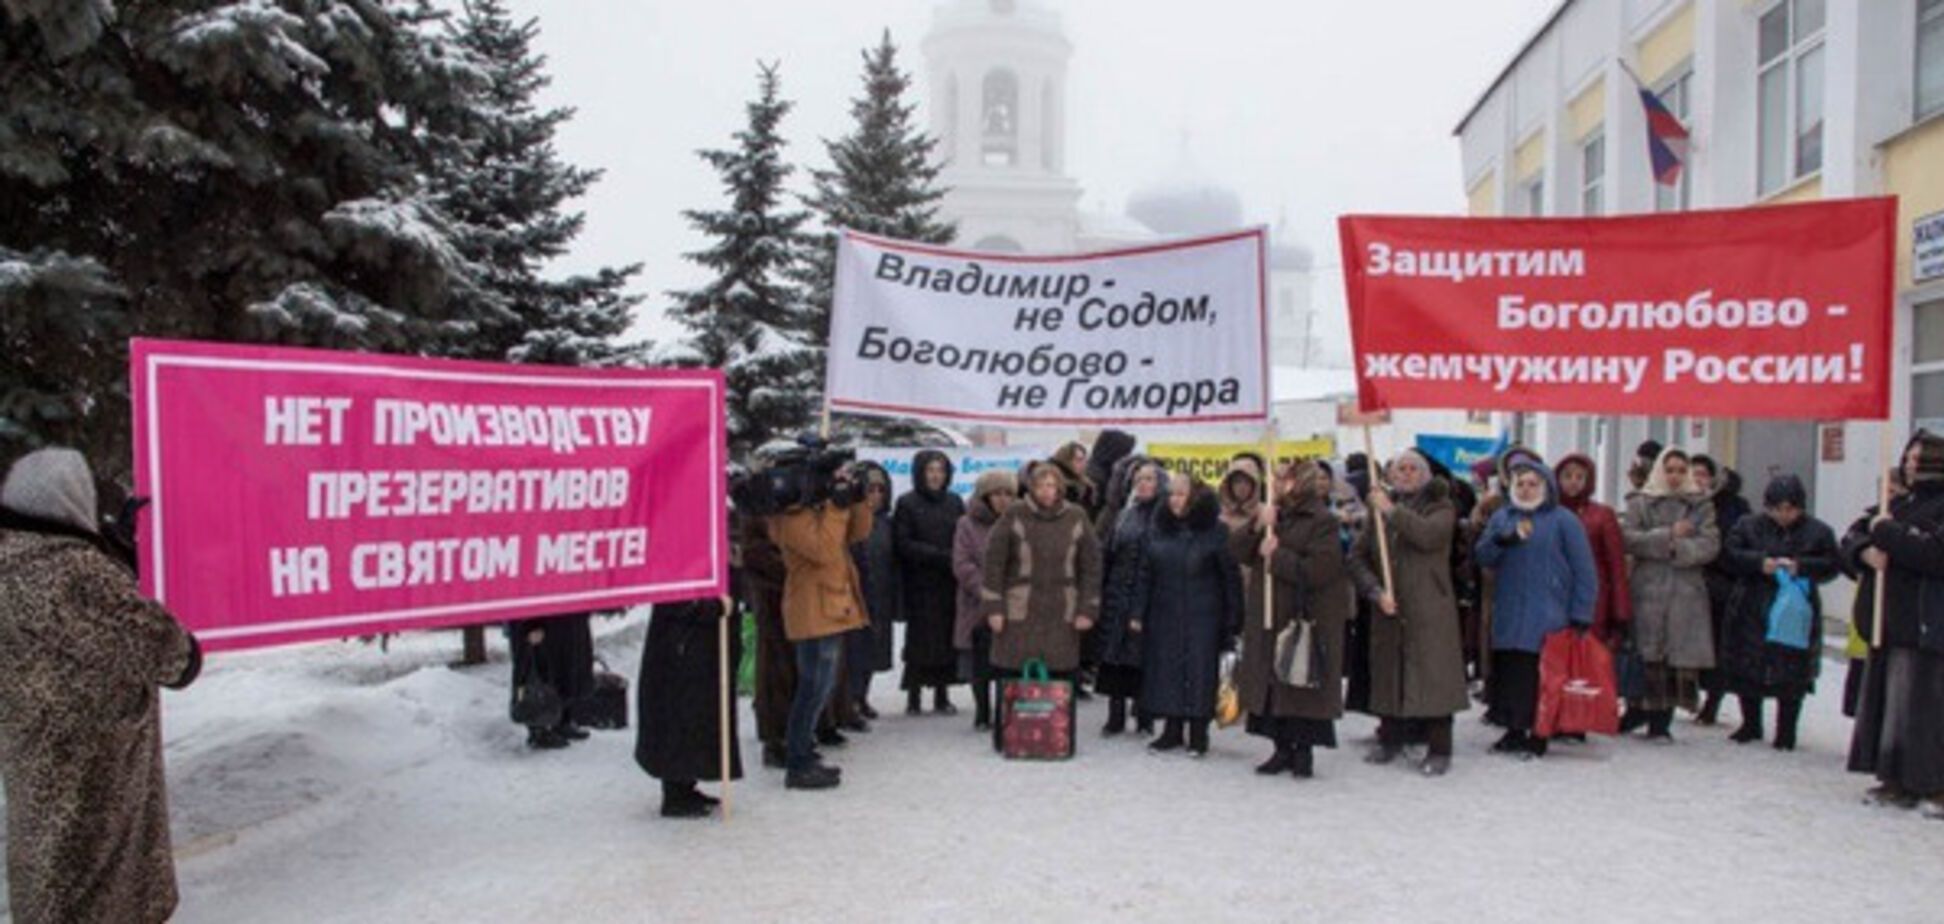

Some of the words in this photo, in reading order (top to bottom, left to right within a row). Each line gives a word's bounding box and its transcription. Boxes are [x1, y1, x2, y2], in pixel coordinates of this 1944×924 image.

[874, 252, 1090, 305] Владимир
[1365, 243, 1586, 282] Защитим
[1013, 306, 1064, 331] не
[1077, 291, 1216, 331] Содом,
[1497, 291, 1809, 330] Боголюбово
[857, 326, 1129, 377] Боголюбово
[1363, 353, 1648, 393] жемчужину
[1663, 342, 1864, 383] России!
[998, 385, 1048, 409] не
[1060, 377, 1241, 414] Гоморра
[264, 397, 352, 445] НЕТ
[373, 398, 652, 454] ПРОИЗВОДСТВУ
[308, 467, 630, 519] ПРЕЗЕРВАТИВОВ
[271, 545, 330, 597] НА
[350, 535, 520, 589] СВЯТОМ
[535, 526, 647, 575] МЕСТЕ!
